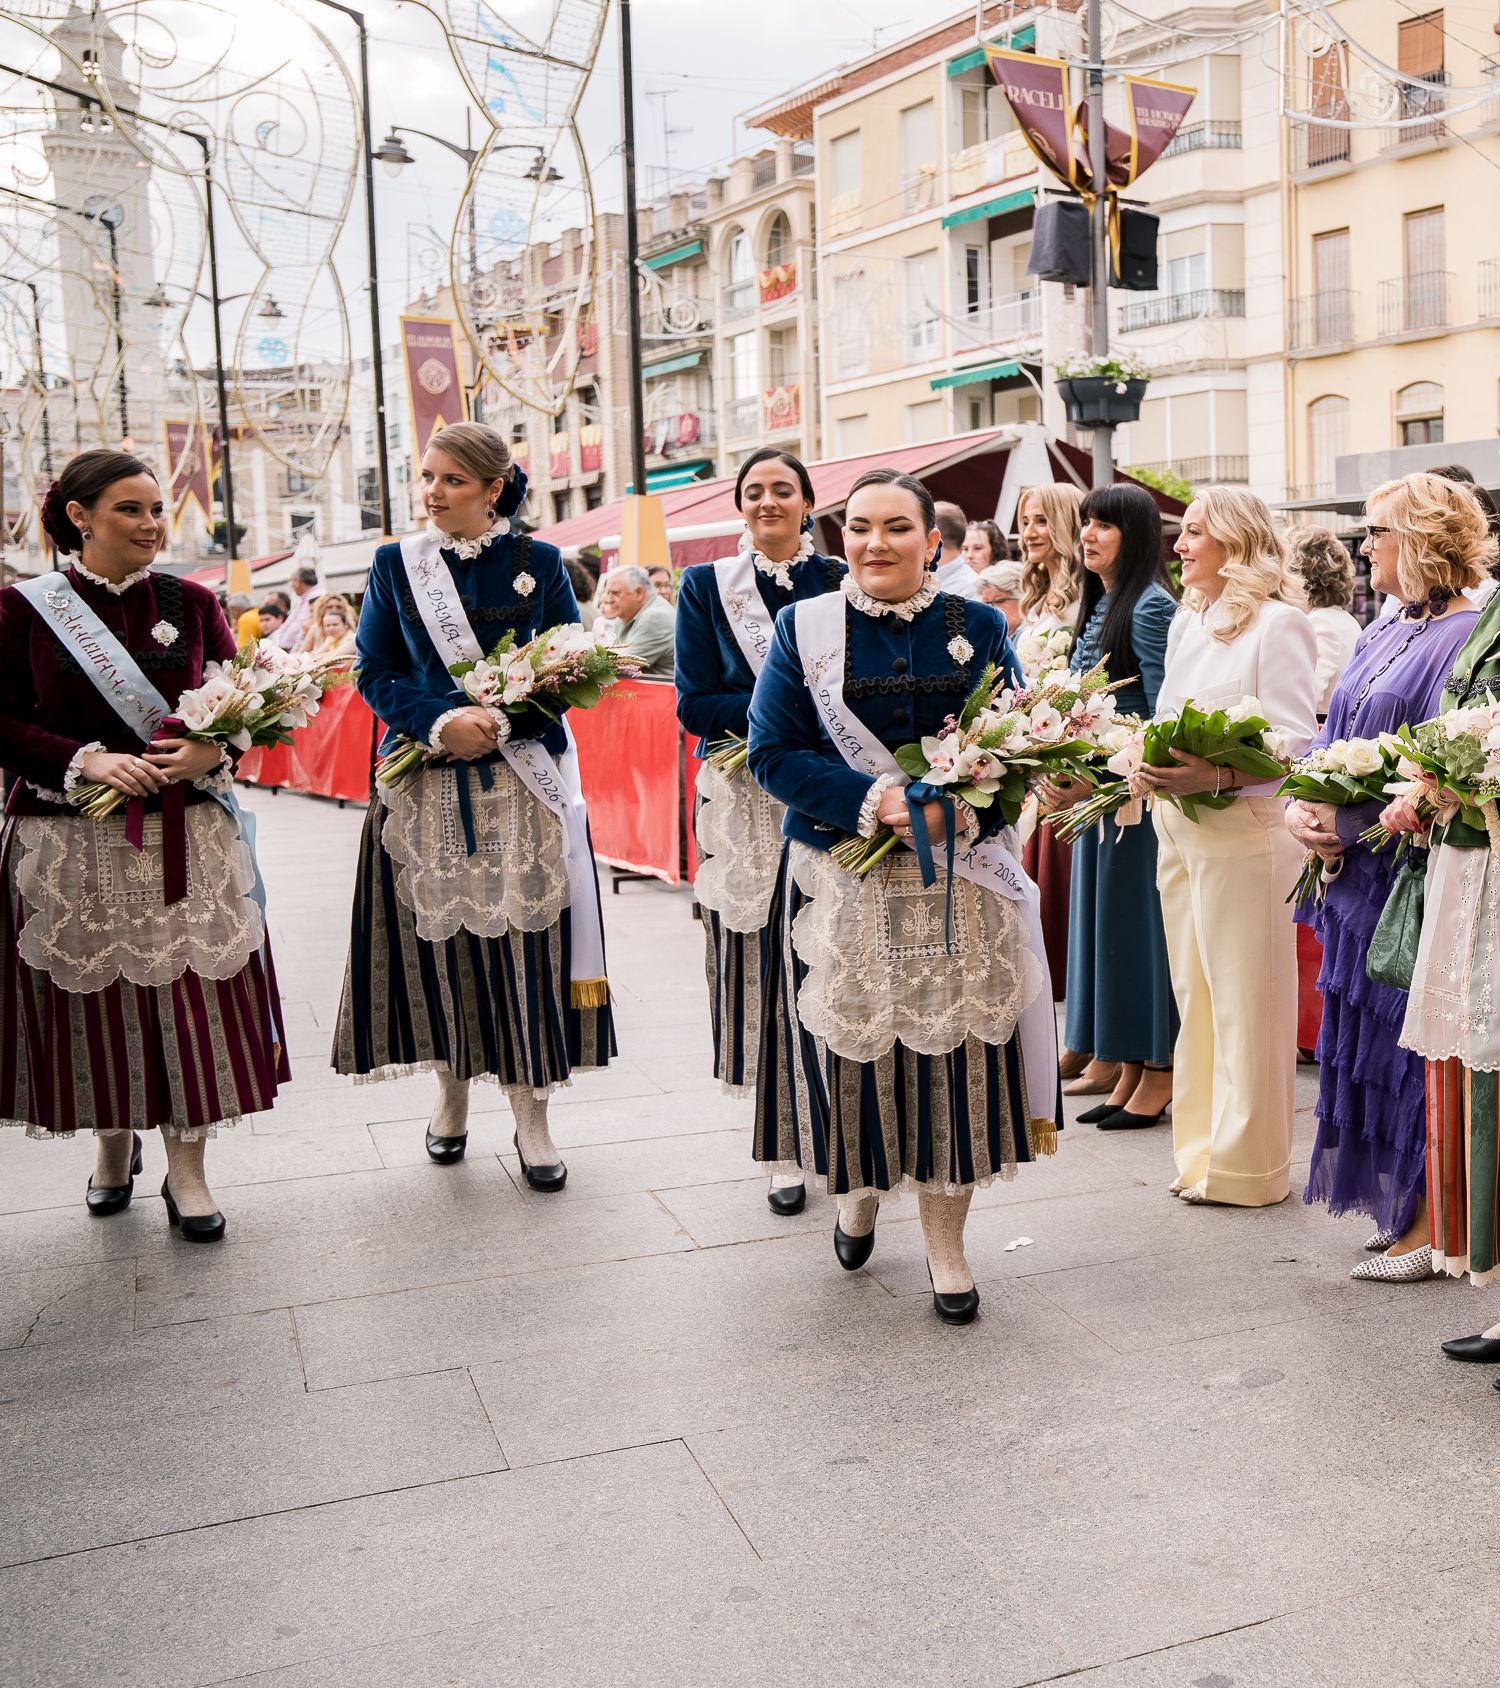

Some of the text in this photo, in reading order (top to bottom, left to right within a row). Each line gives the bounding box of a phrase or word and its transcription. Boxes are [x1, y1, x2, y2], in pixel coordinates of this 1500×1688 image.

[1007, 84, 1064, 111] RACELI
[427, 588, 461, 643] DAMA
[818, 689, 864, 760] DAMA
[532, 769, 564, 802] 2026
[994, 862, 1022, 891] 2026
